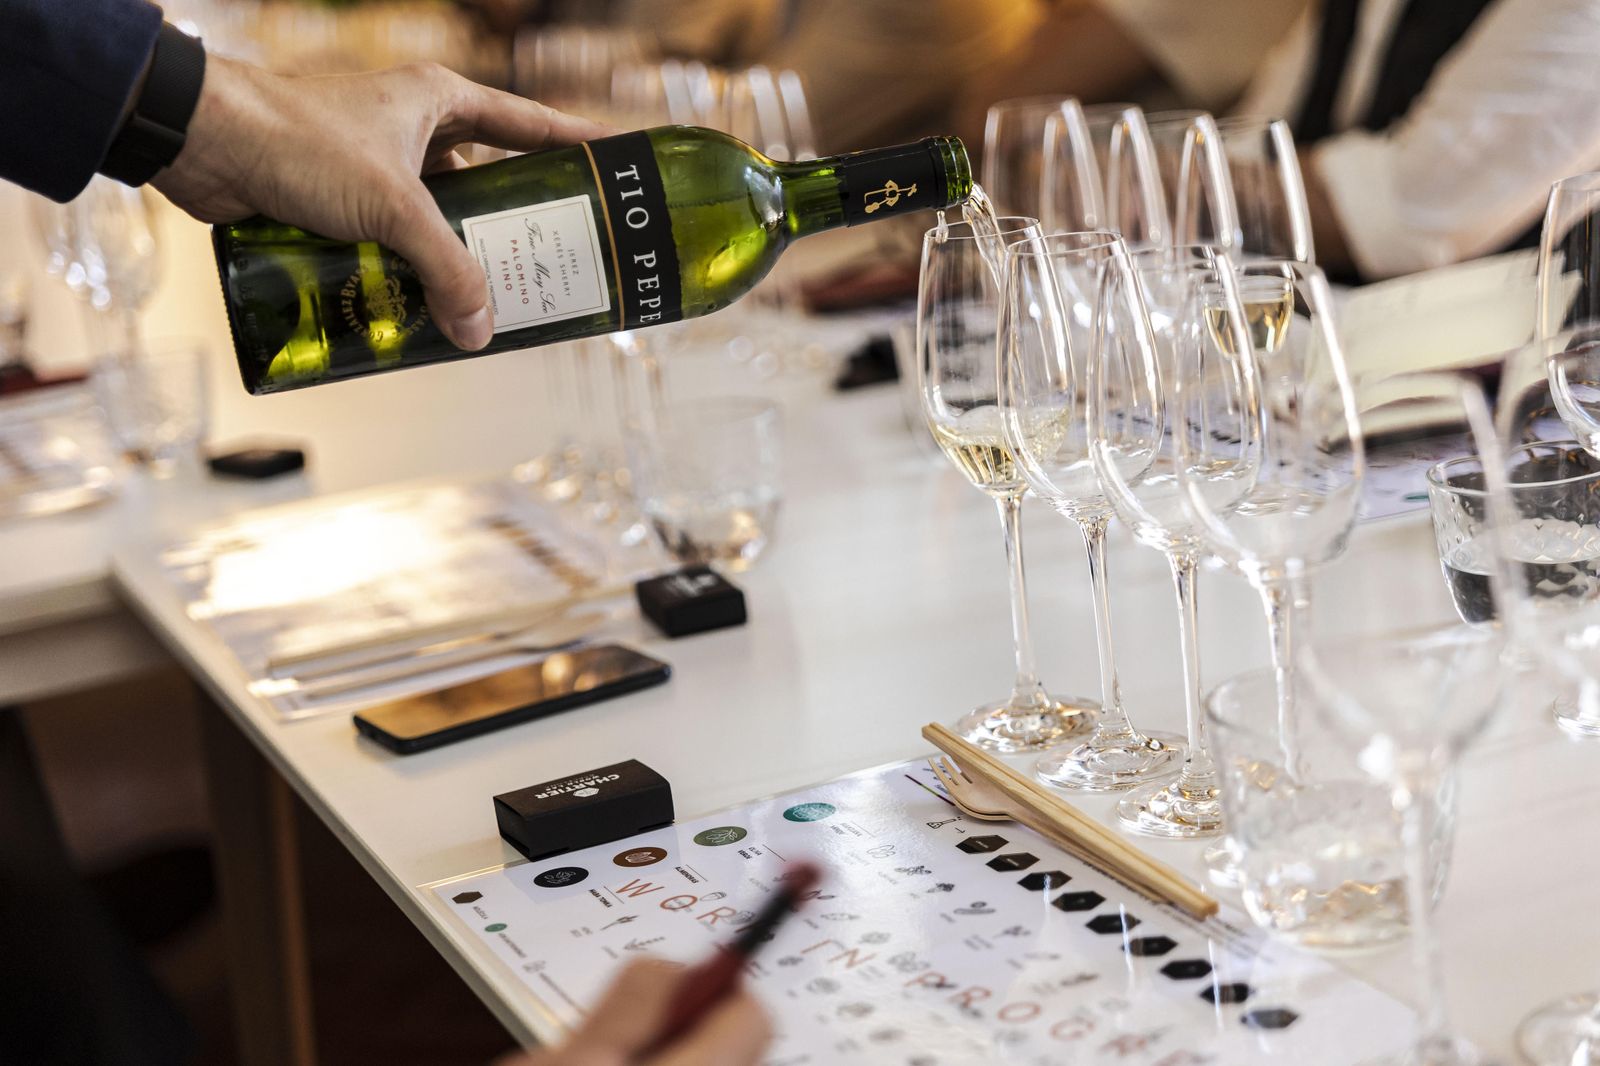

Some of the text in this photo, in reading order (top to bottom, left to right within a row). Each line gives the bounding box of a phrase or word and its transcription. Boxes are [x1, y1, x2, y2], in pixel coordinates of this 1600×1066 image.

[524, 217, 557, 314] Fino Muy Seco
[567, 248, 580, 275] JEREZ
[615, 164, 662, 323] TIO PEPE
[500, 239, 530, 306] PALOMINO FINO
[558, 263, 571, 297] SHERRY
[341, 298, 384, 343] GONZALEZ
[534, 774, 620, 799] CHARTIER
